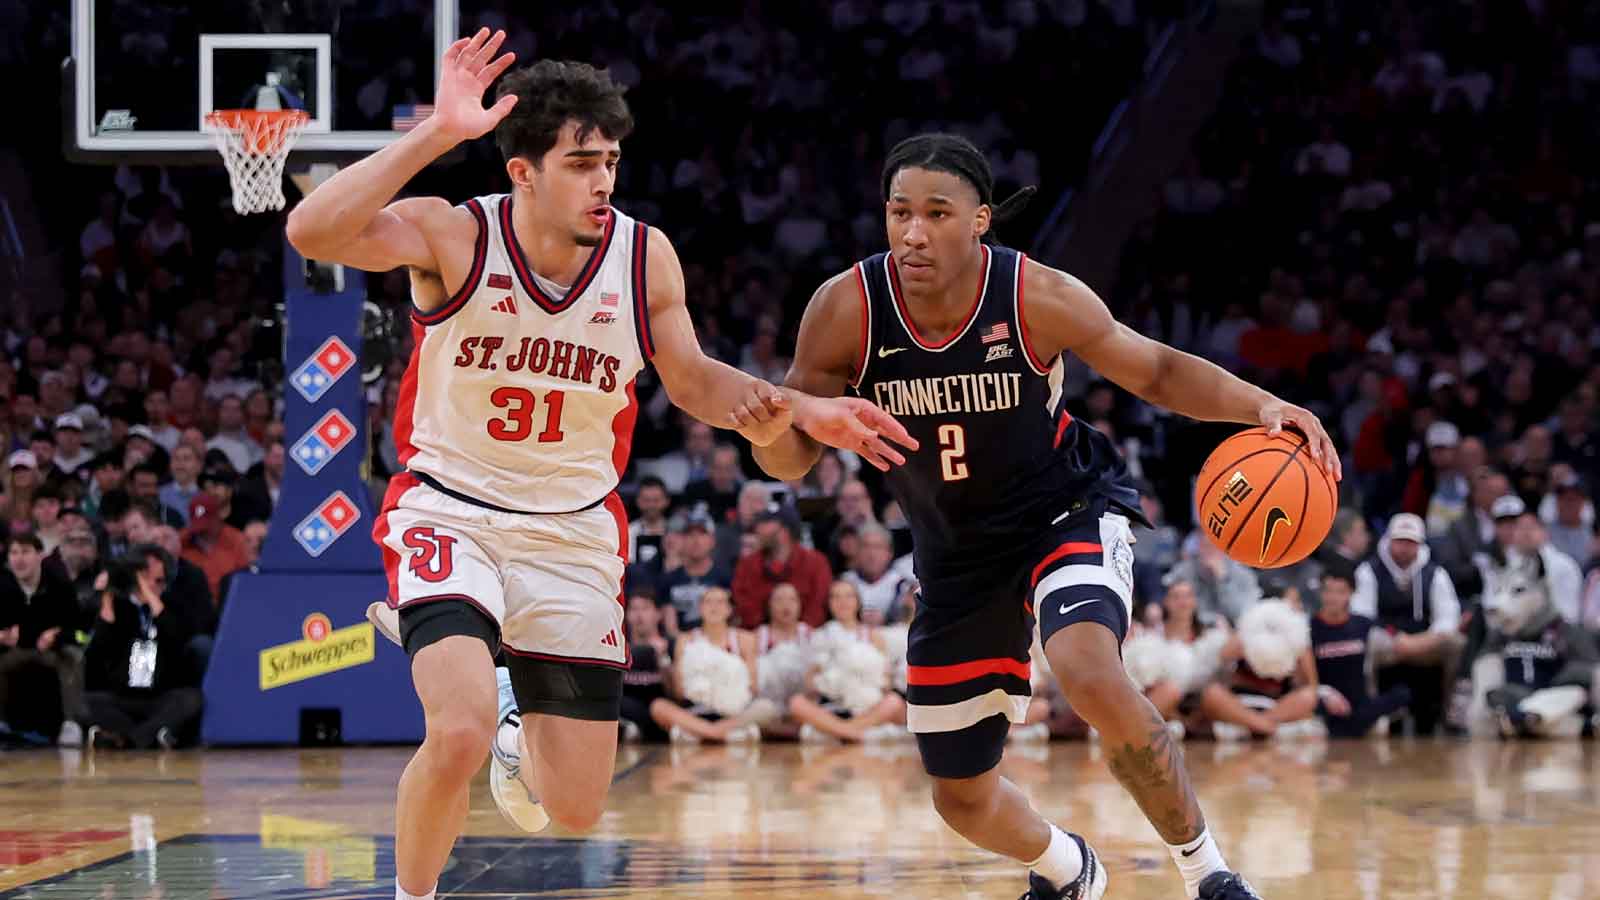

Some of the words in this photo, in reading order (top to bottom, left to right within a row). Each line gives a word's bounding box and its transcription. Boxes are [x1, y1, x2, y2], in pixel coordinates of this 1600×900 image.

[454, 337, 504, 370] ST.
[506, 337, 621, 393] JOHN'S
[487, 386, 565, 443] 31
[874, 372, 1022, 416] CONNECTICUT
[938, 424, 969, 482] 2
[1209, 476, 1253, 539] ELITE
[268, 637, 369, 681] Schweppes
